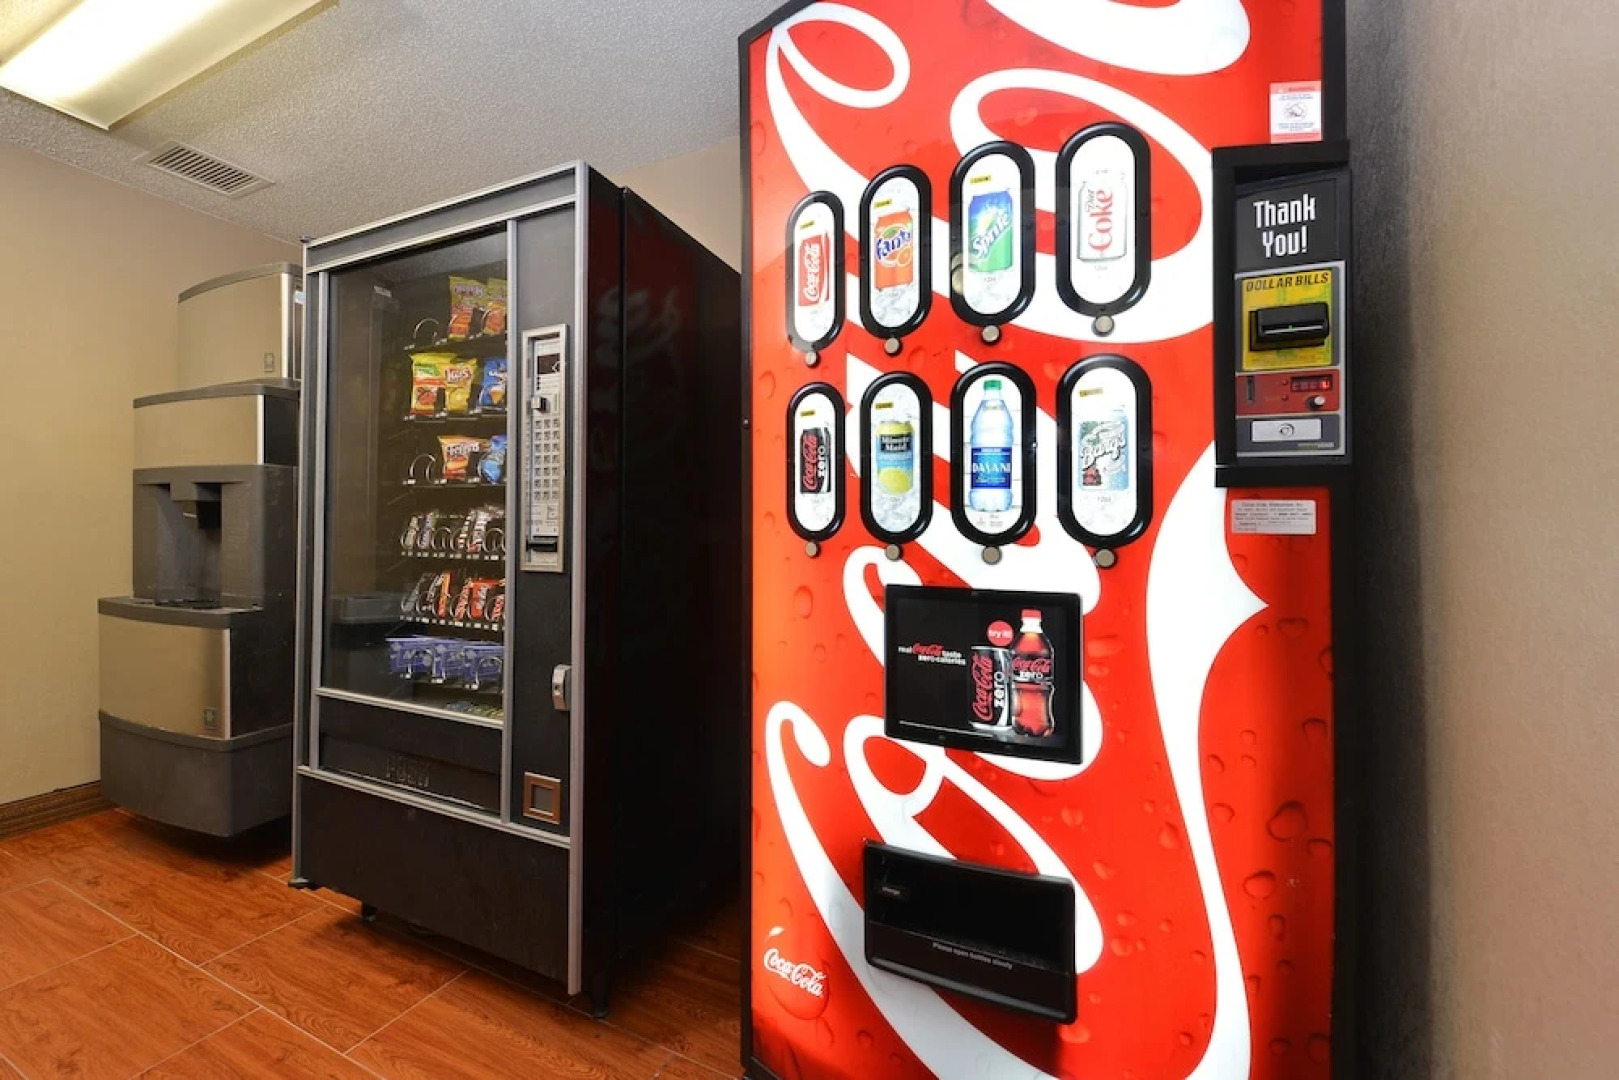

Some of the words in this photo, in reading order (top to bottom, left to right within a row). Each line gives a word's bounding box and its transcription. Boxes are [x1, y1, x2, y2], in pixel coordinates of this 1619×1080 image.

[1088, 190, 1113, 251] Coke
[1253, 193, 1316, 228] Thank
[971, 207, 1011, 260] Sprite
[1262, 225, 1308, 258] You!
[1246, 276, 1293, 292] DOLLAR
[1294, 271, 1329, 286] BILLS
[817, 445, 827, 477] zero
[972, 462, 1012, 474] DASANI
[1012, 656, 1051, 673] Coca-Cola
[1020, 671, 1043, 681] zero
[972, 652, 993, 721] Coca-Cola
[994, 671, 1004, 708] zero
[763, 948, 827, 997] Coca-Cola
